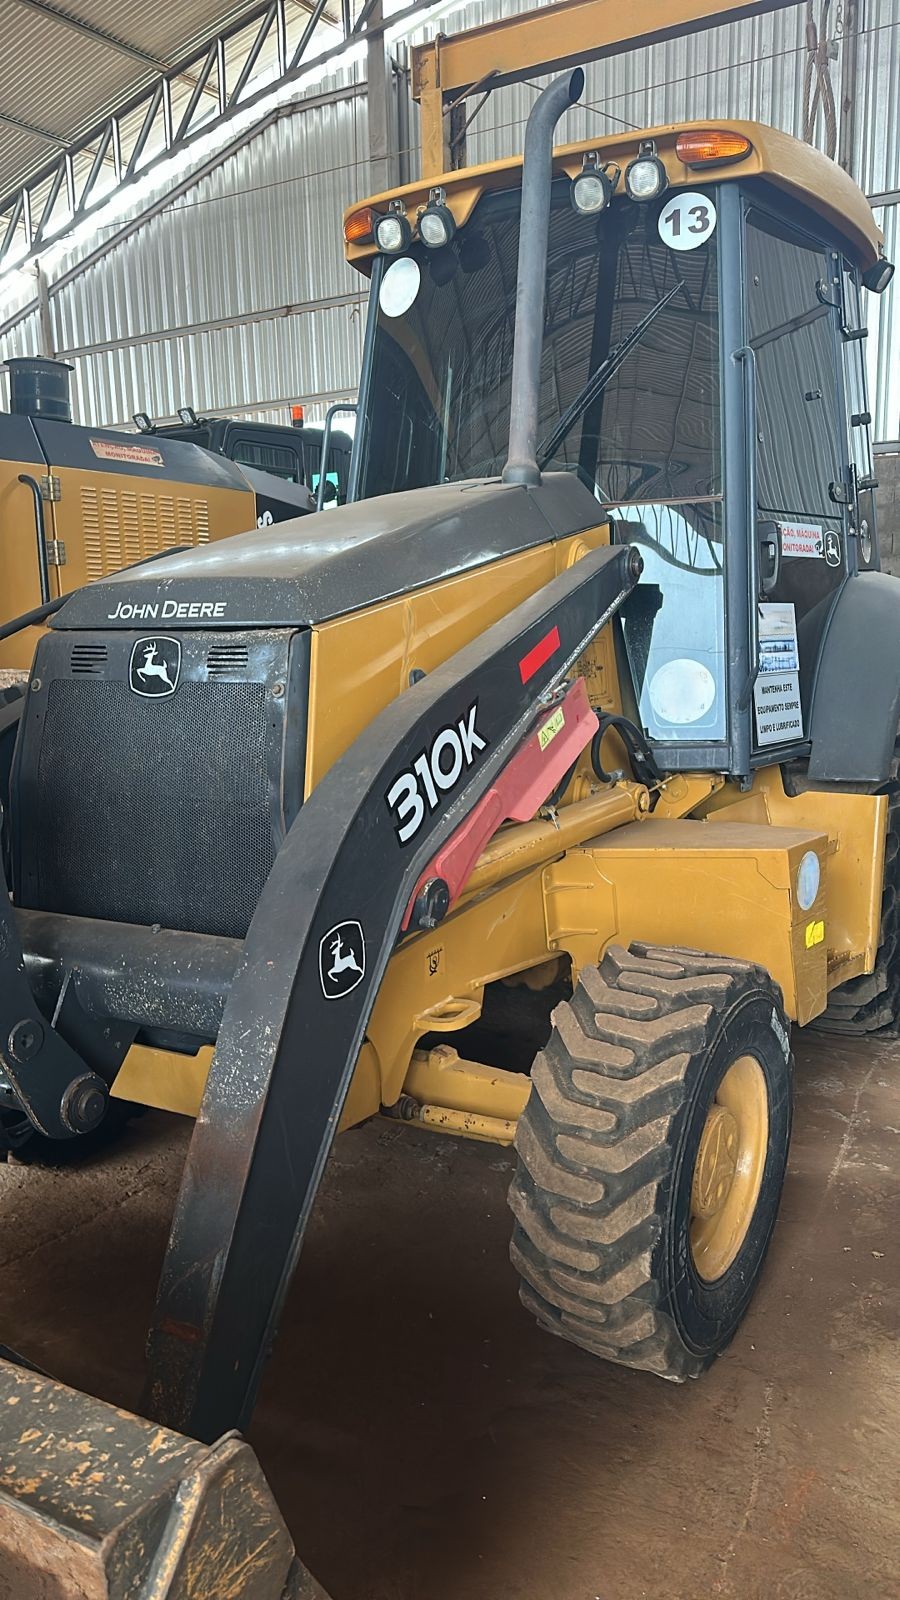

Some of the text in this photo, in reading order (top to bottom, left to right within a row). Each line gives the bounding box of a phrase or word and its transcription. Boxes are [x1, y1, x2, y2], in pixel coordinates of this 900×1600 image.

[664, 205, 710, 236] 13
[783, 527, 796, 539] ÇÃO,
[783, 542, 814, 553] ONITORADA!
[107, 600, 228, 619] JOHN DEERE
[761, 683, 793, 694] MANTENHA ESTE
[757, 701, 799, 715] EQUIPAMENTO SEMPRE
[759, 719, 800, 734] LIMPO E LUBRIFICADO
[386, 704, 487, 843] 310K
